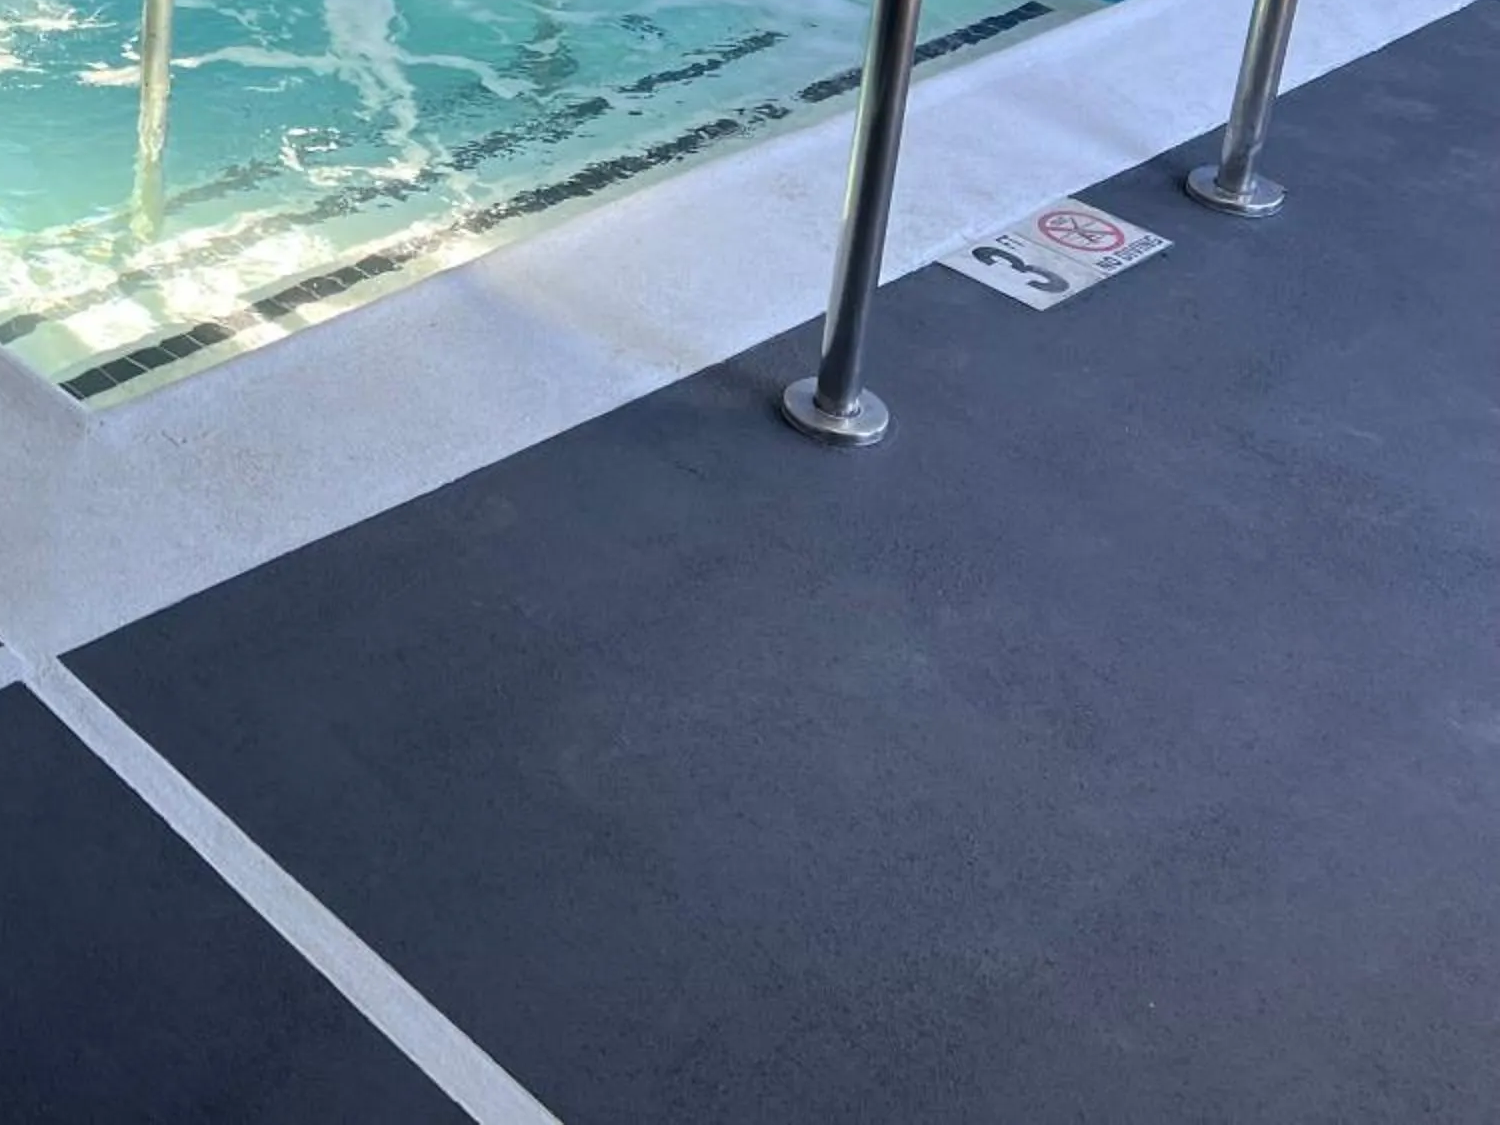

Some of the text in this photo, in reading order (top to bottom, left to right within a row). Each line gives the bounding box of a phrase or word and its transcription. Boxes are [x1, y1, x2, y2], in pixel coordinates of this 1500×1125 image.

[972, 246, 1070, 294] 3
[1096, 234, 1164, 272] NO DIVING
